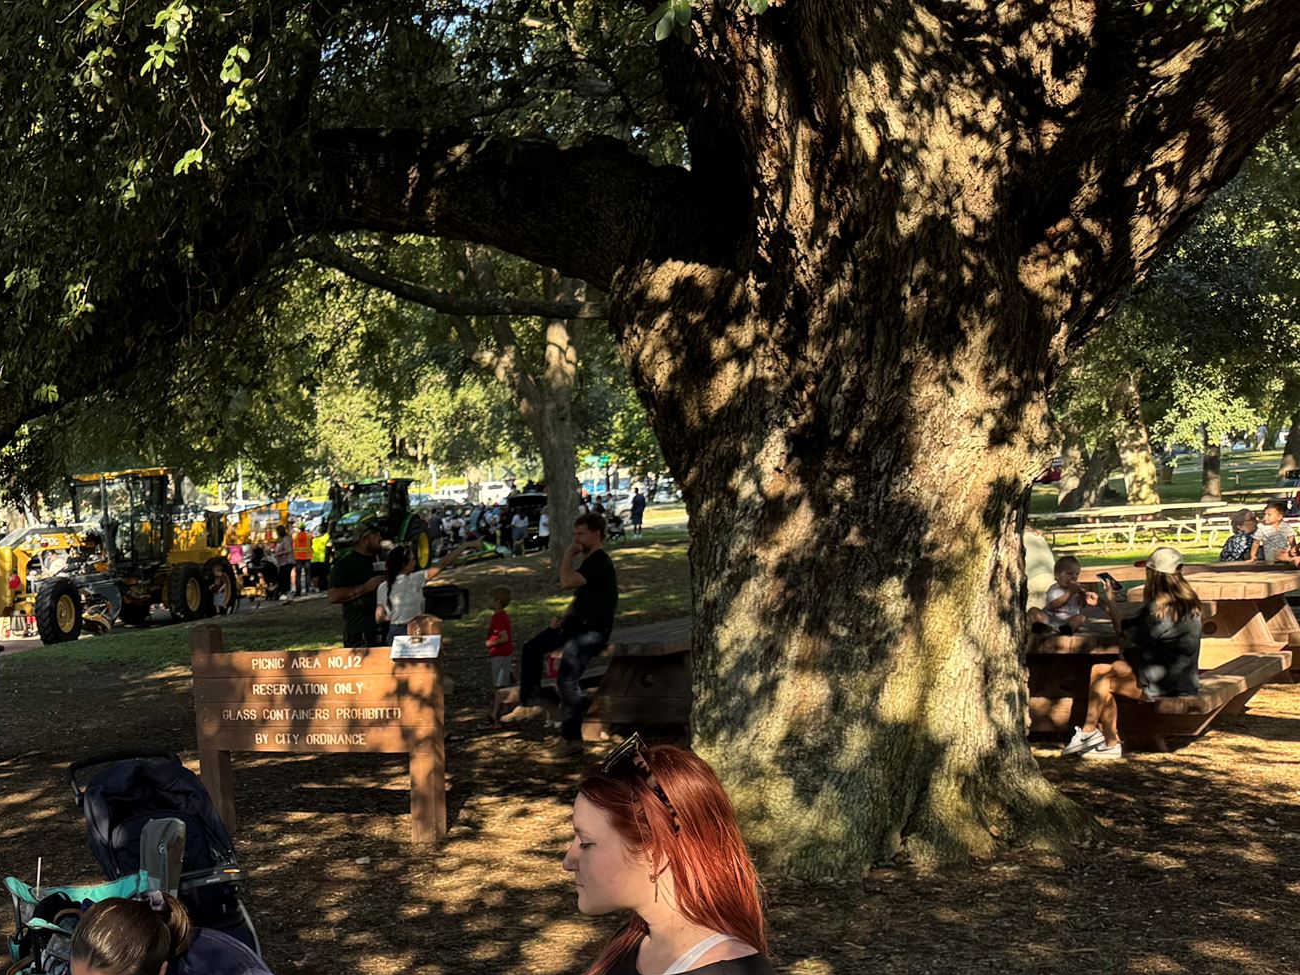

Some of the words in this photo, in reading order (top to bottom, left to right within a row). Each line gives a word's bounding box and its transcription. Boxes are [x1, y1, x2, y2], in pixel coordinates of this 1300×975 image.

[252, 658, 284, 670] PICNIC
[292, 658, 320, 669] AREA
[328, 656, 362, 670] NO.12
[253, 684, 328, 695] RESERVATION
[334, 683, 364, 694] ONLY
[223, 709, 257, 720] GLASS
[263, 708, 329, 720] CONTAINERS
[336, 708, 401, 719] PROHIBITED
[255, 734, 268, 745] BY
[275, 733, 299, 745] CITY
[306, 733, 367, 745] ORDINANCE
